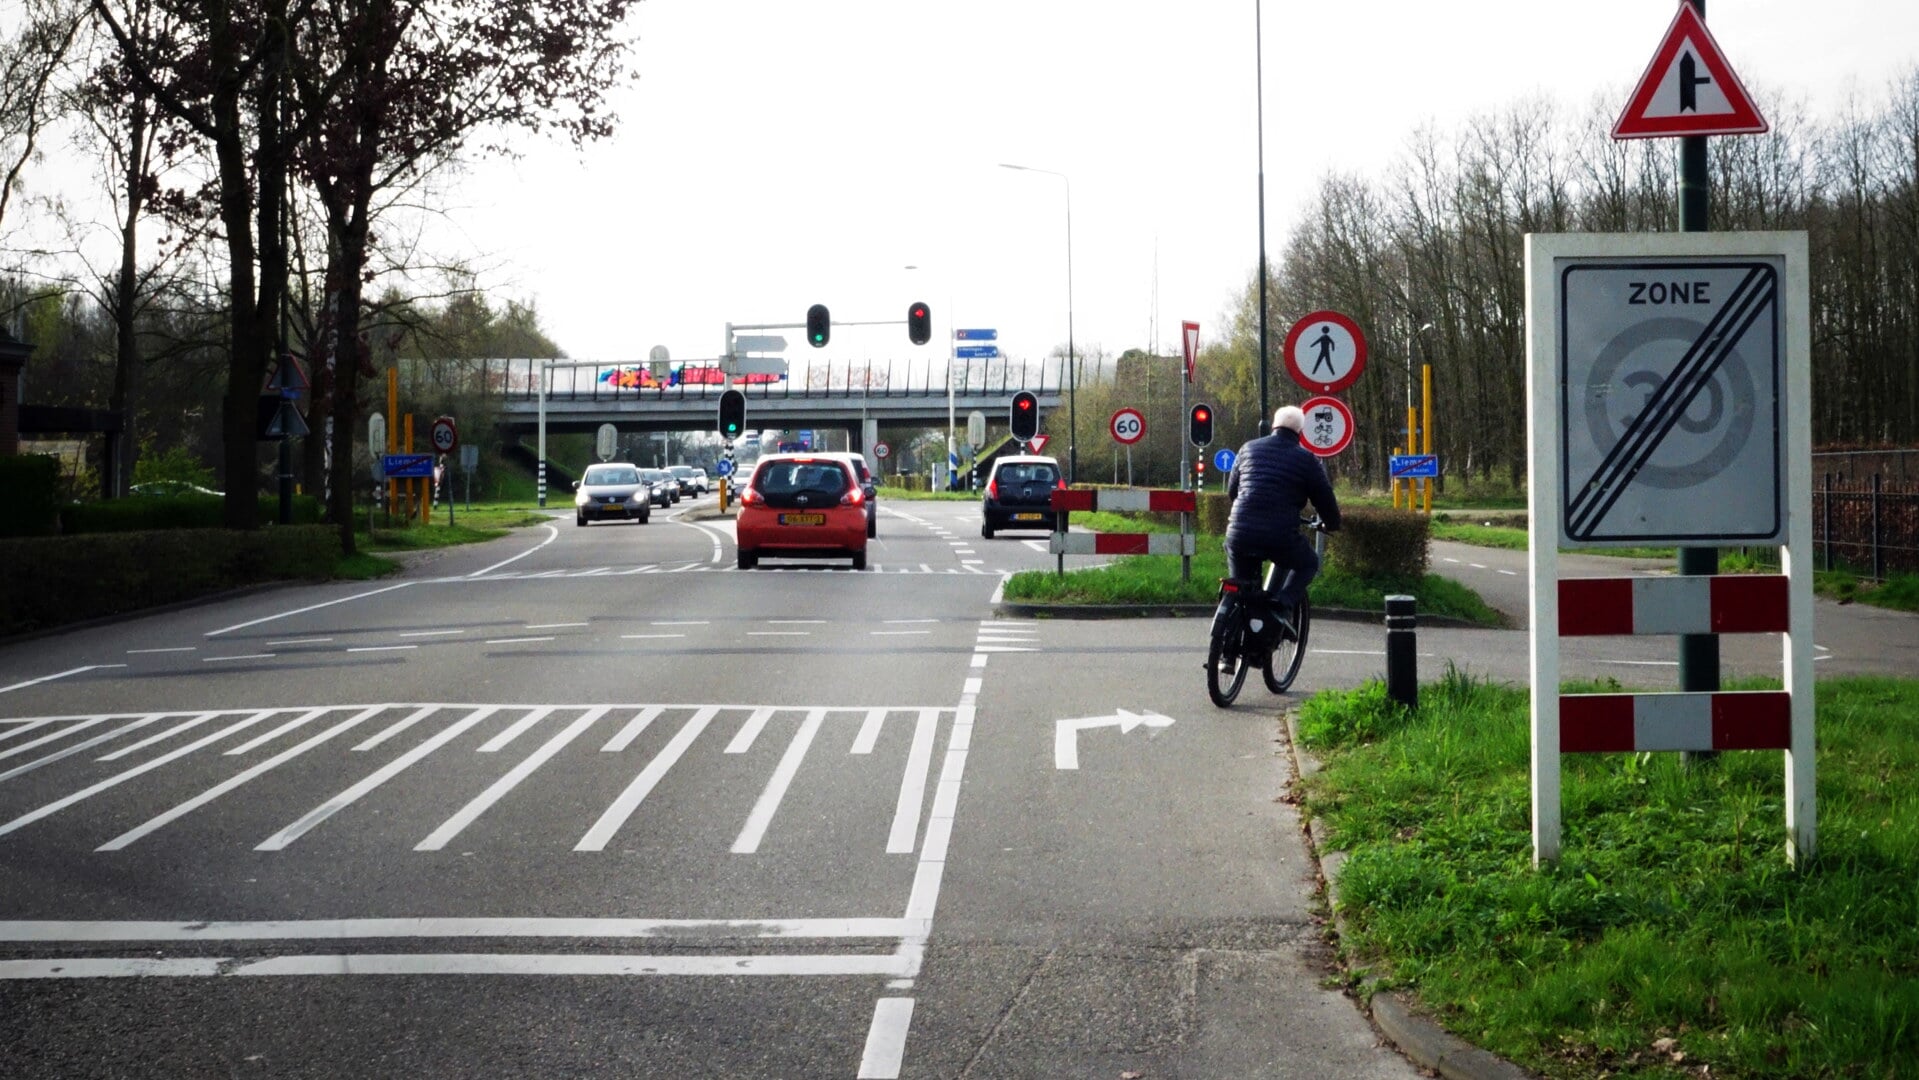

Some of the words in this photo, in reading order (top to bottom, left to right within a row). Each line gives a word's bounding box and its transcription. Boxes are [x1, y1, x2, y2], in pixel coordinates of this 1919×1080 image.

[1628, 282, 1711, 305] ZONE
[1619, 370, 1724, 434] 30
[1117, 420, 1140, 434] 60
[436, 430, 453, 444] 60
